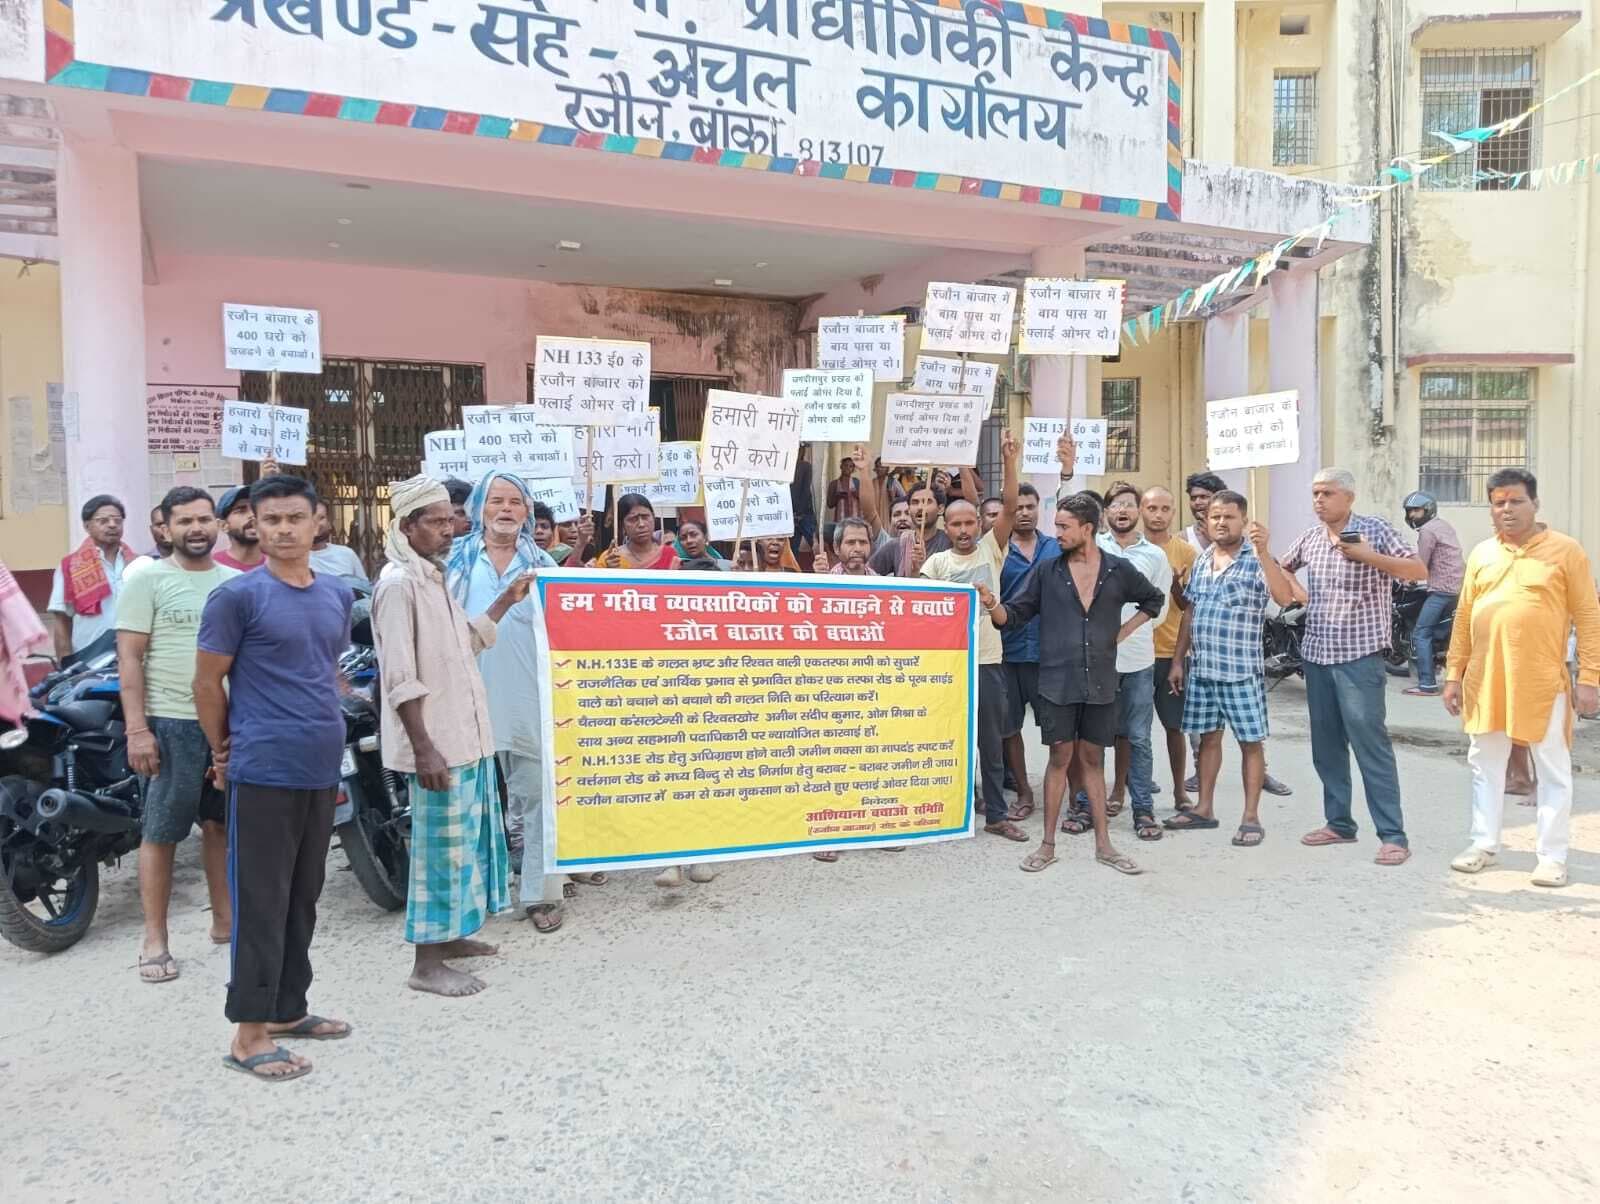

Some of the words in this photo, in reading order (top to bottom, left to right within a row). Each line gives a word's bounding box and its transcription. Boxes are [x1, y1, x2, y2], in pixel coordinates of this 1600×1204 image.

[1045, 19, 1151, 107] केन्द्र
[634, 20, 811, 114] अंचल
[856, 67, 1082, 150] कार्यालय
[1030, 286, 1061, 299] रजौन
[1068, 288, 1100, 300] बाजार
[1107, 287, 1116, 300] में
[1065, 310, 1087, 319] पास
[1094, 310, 1106, 320] या
[1027, 326, 1054, 339] फ्लाई
[544, 349, 570, 364] NH
[577, 351, 602, 365] 133
[632, 353, 644, 367] के
[540, 372, 576, 386] रजौन
[583, 376, 620, 389] बाजार
[628, 376, 644, 390] को
[539, 395, 574, 410] फ्लाई
[712, 403, 758, 427] हमारी
[768, 408, 799, 432] मांगें
[1029, 423, 1047, 433] NH
[430, 438, 456, 451] NH
[711, 440, 738, 470] पूरी
[439, 461, 468, 472] मनम
[559, 593, 595, 611] हम
[602, 589, 658, 612] गरीब
[664, 591, 780, 613] व्यवसायिकों
[786, 593, 812, 613] को
[820, 594, 882, 618] उजाड़ने
[889, 595, 905, 615] से
[661, 619, 718, 640] रजौन
[725, 624, 784, 641] बाजार
[790, 620, 817, 641] को
[824, 621, 885, 642] बचाओं
[577, 658, 638, 669] N.H.133E
